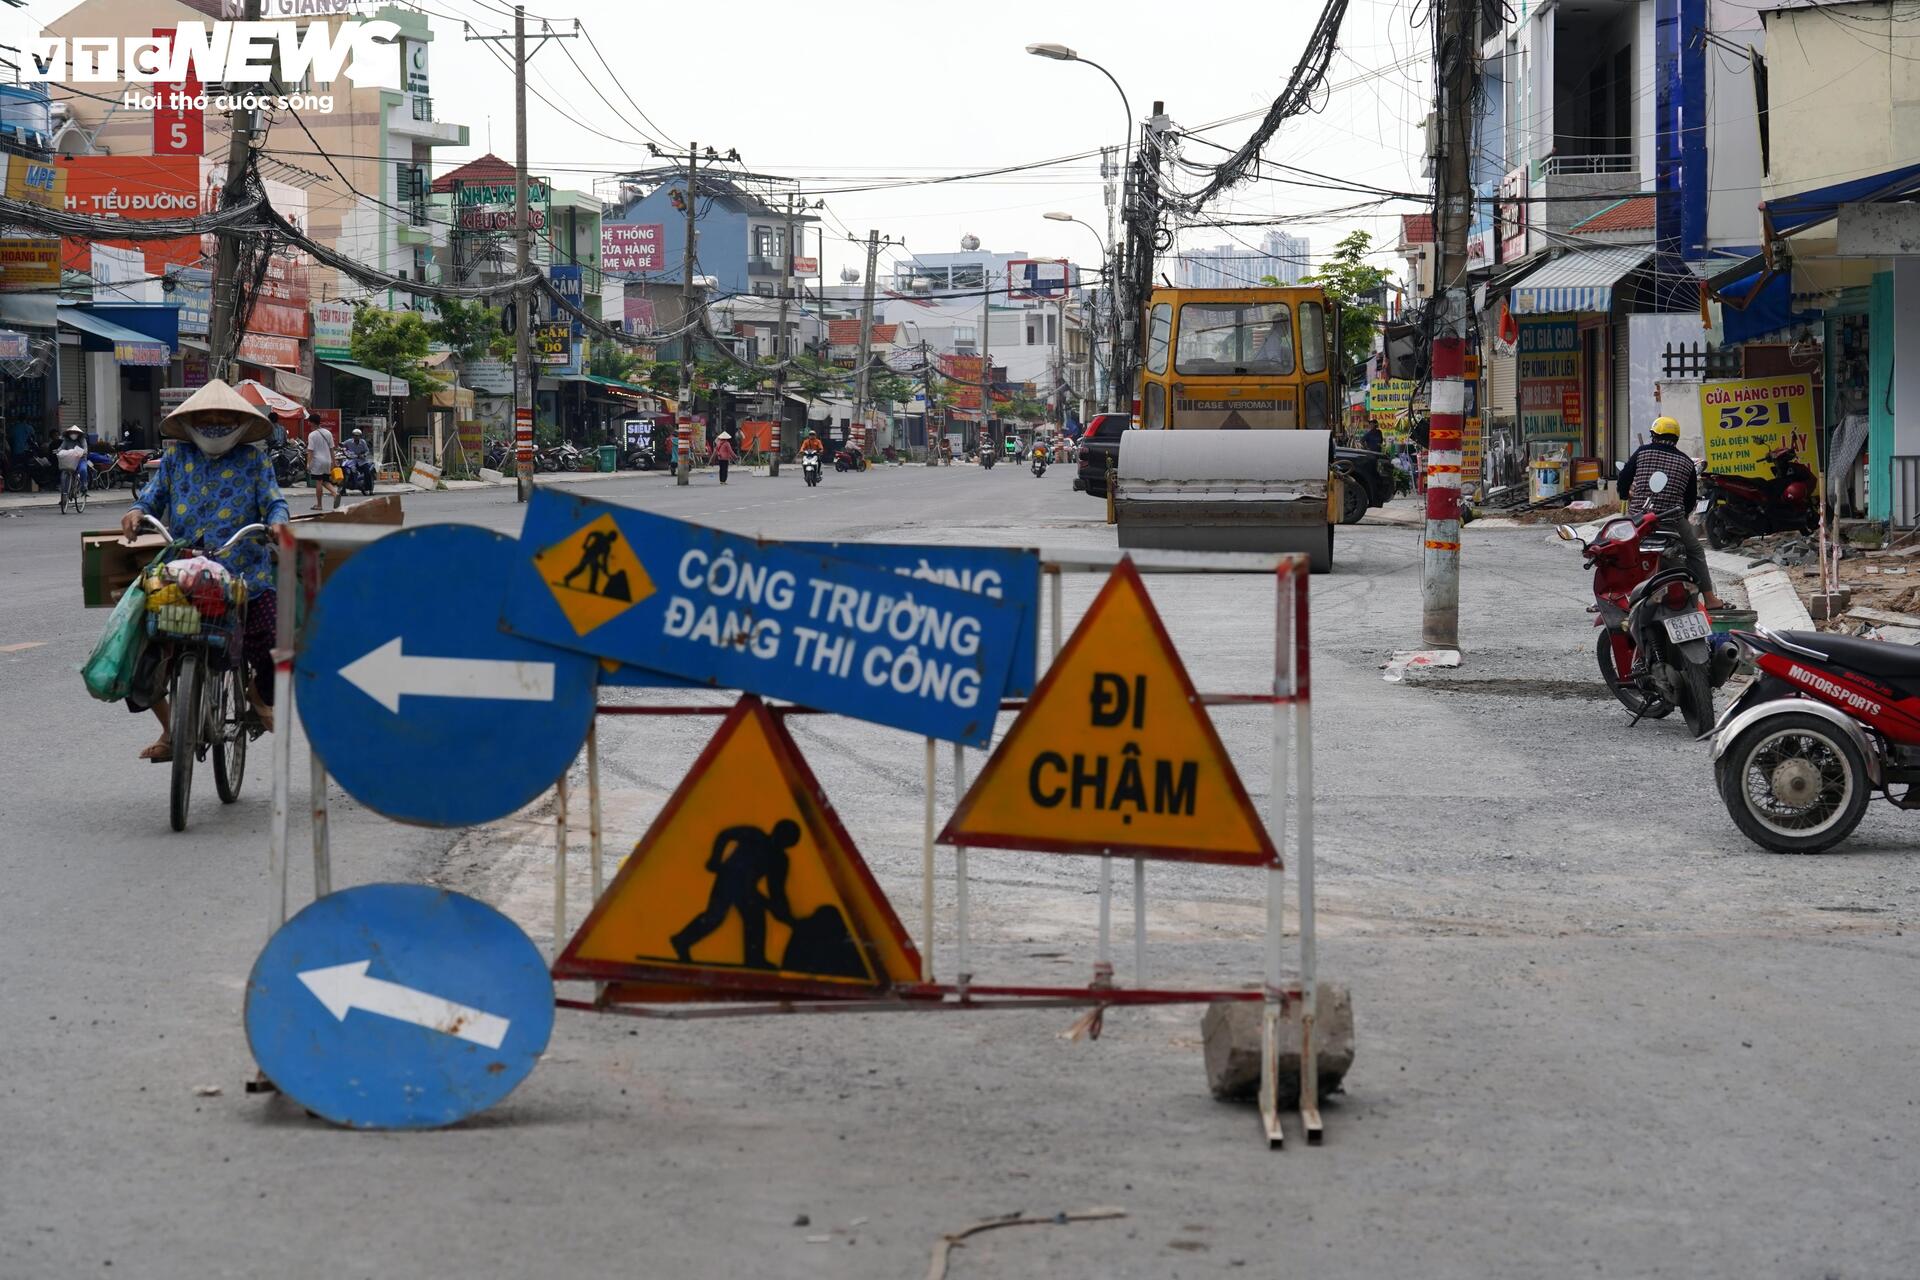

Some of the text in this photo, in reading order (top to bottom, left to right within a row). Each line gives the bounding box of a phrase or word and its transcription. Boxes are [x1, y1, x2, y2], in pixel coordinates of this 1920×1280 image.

[91, 187, 129, 210] TIỂU
[132, 191, 197, 210] ĐƯỜNG
[617, 225, 654, 239] THỐNG
[625, 242, 655, 254] HÀNG
[604, 255, 651, 270] MẸ VÀ BÉ
[1198, 401, 1273, 409] CASE VIBROMAX
[1706, 385, 1805, 404] CỬA HÀNG ĐTDĐ
[1720, 402, 1792, 429] 521
[1711, 449, 1750, 461] THAY PIN
[677, 548, 983, 656] CÔNG TRƯỜNG
[664, 595, 983, 708] ĐANG THI CÔNG
[1090, 672, 1147, 729] ĐI
[1788, 664, 1881, 715] MOTORSPORTS
[1029, 742, 1198, 824] CHẬM
